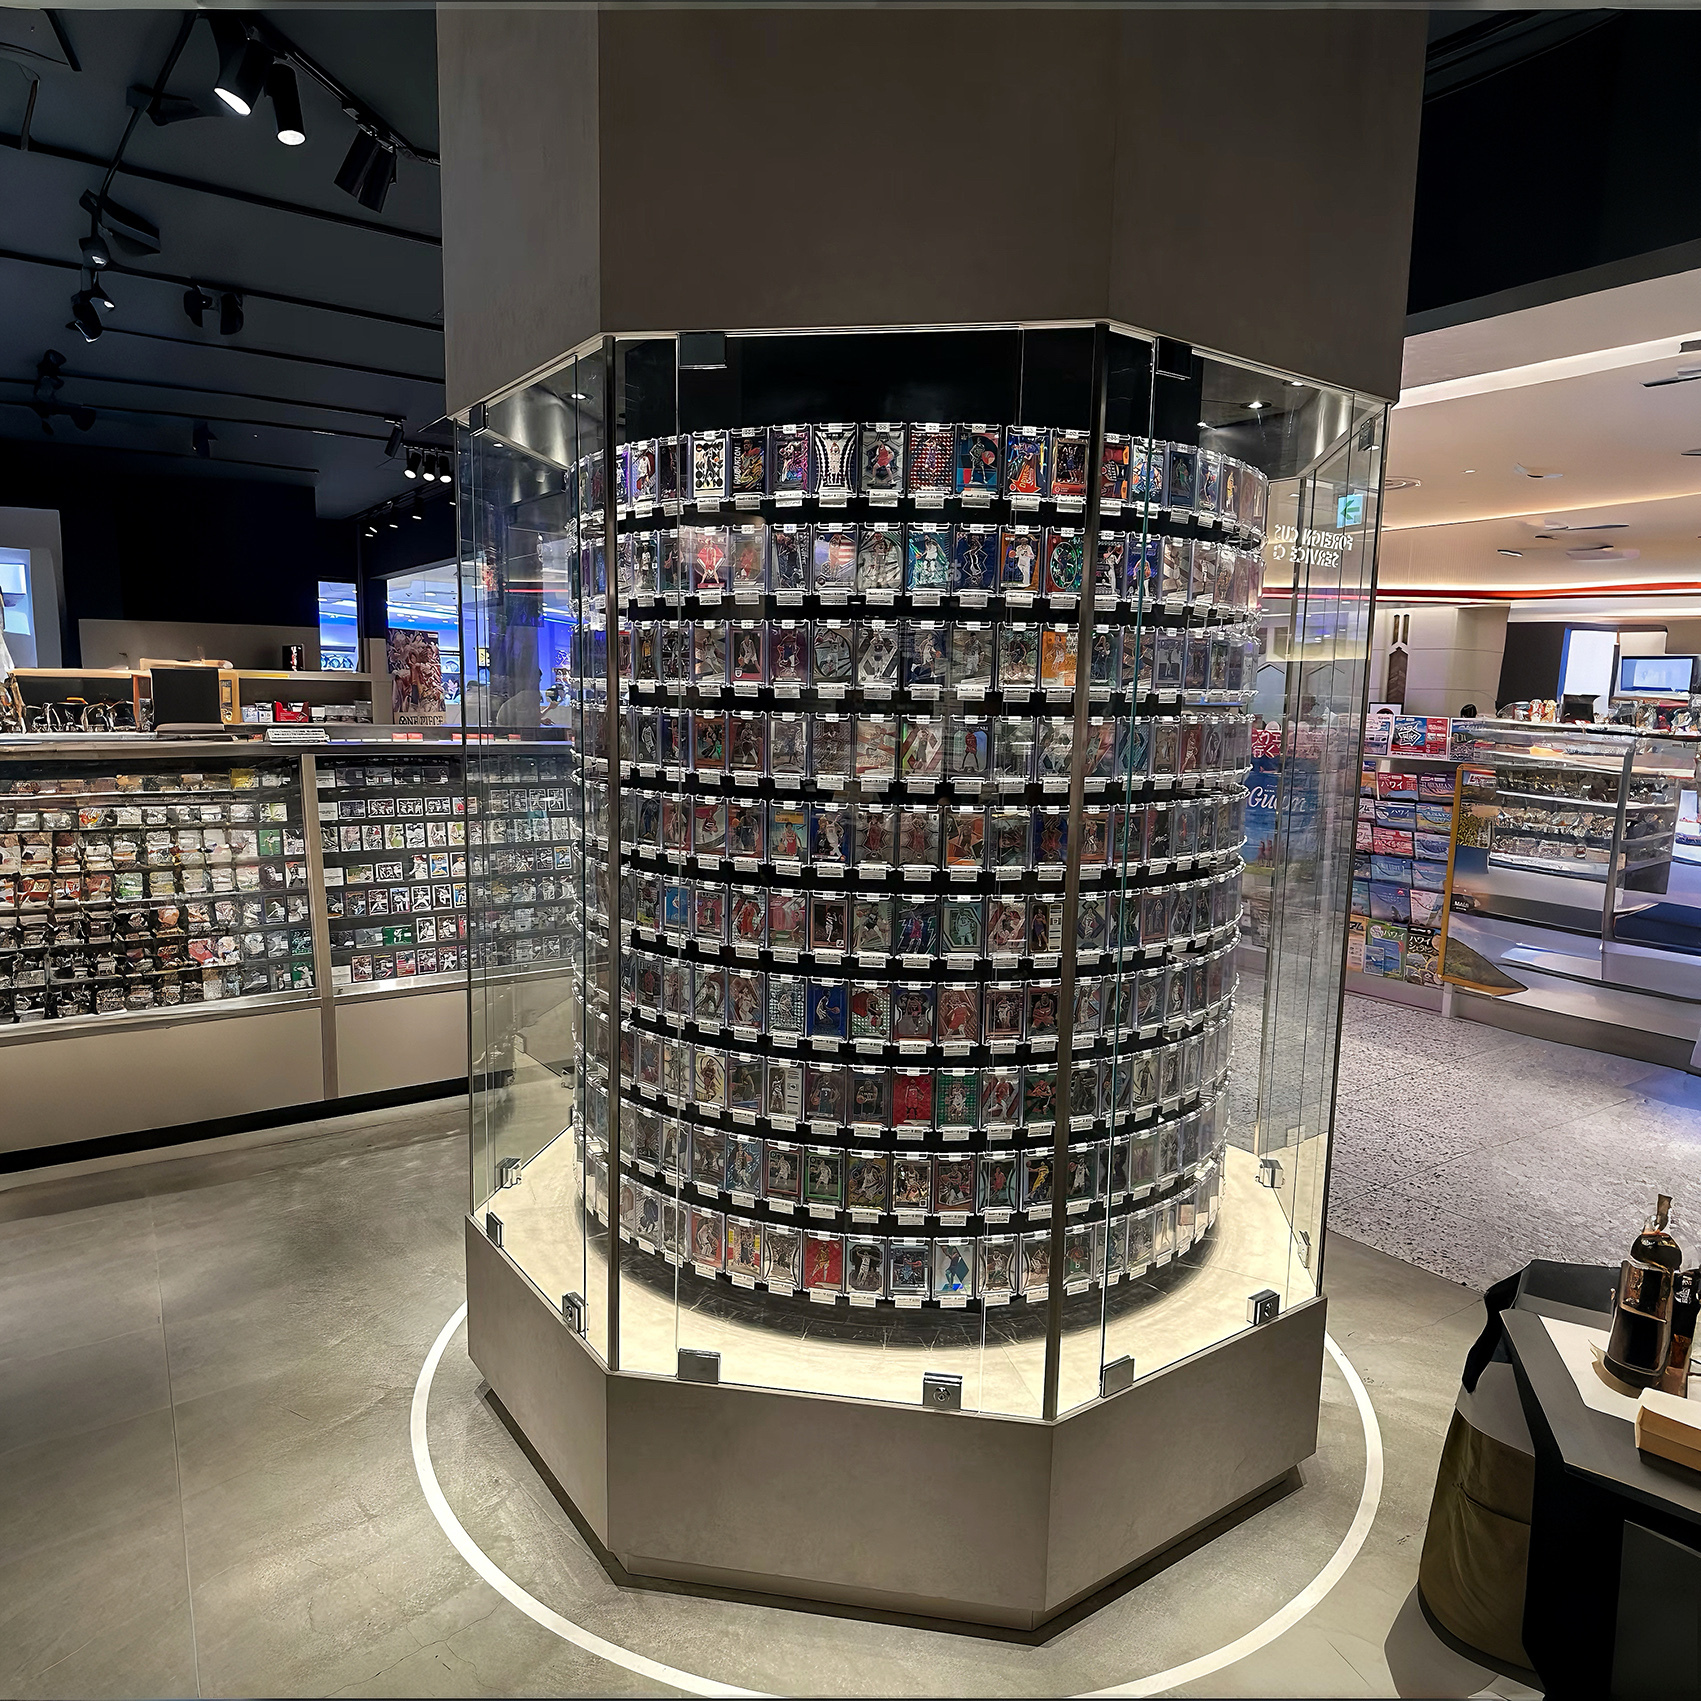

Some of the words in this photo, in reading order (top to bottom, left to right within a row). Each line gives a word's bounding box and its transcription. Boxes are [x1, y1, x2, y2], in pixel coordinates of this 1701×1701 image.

[1380, 781, 1403, 790] ハワイ
[1408, 935, 1431, 946] ハワイ
